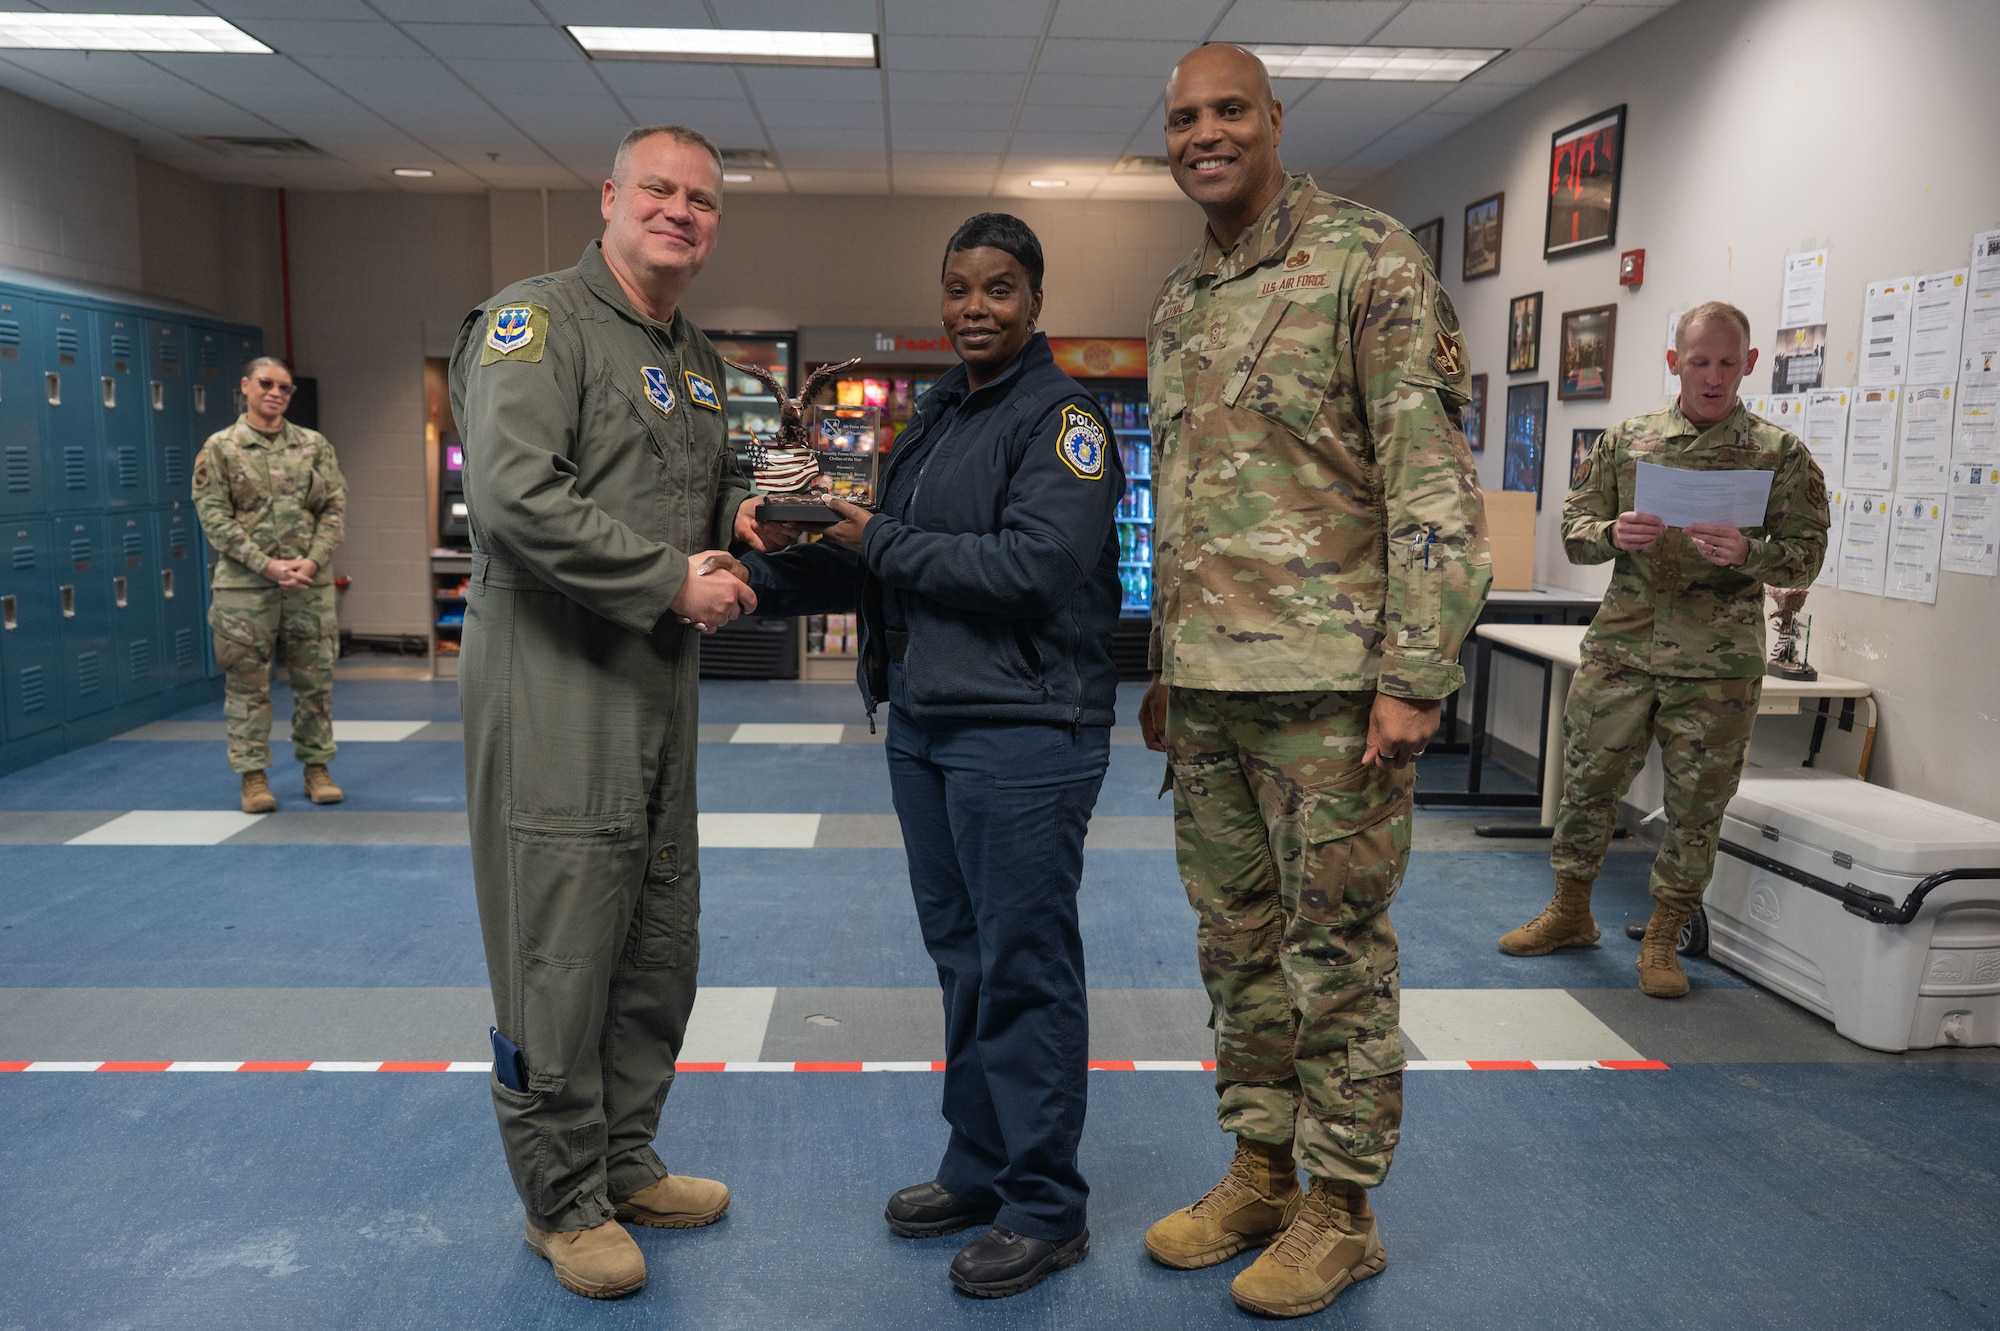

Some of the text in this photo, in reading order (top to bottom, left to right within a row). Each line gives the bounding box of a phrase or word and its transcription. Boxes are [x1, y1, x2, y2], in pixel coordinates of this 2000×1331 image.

[1279, 277, 1294, 290] AIR
[1297, 273, 1328, 288] FORCE
[1068, 413, 1104, 445] POLICE
[1066, 448, 1083, 469] SECURITY
